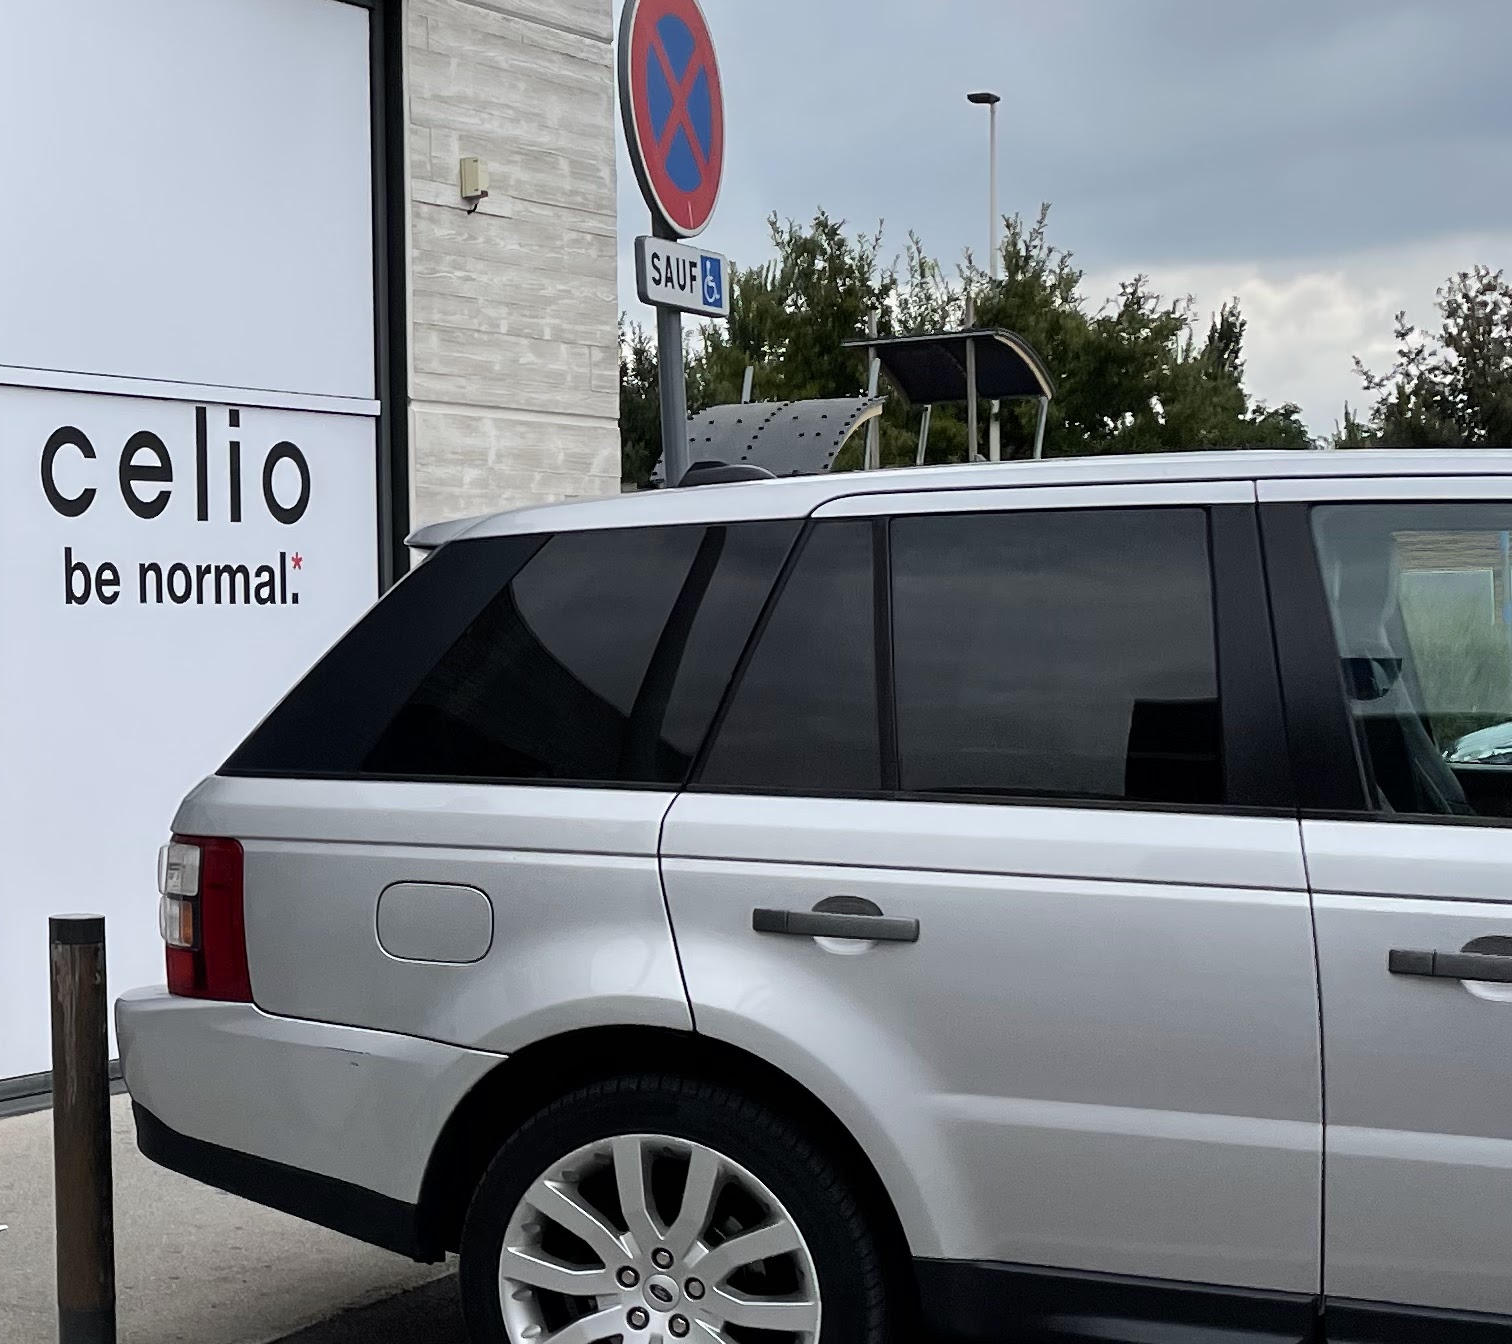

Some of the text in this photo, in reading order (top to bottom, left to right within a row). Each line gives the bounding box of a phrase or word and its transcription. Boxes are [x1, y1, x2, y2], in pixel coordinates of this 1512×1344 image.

[651, 252, 697, 293] SAUF
[41, 406, 310, 524] celio
[64, 547, 120, 604] be
